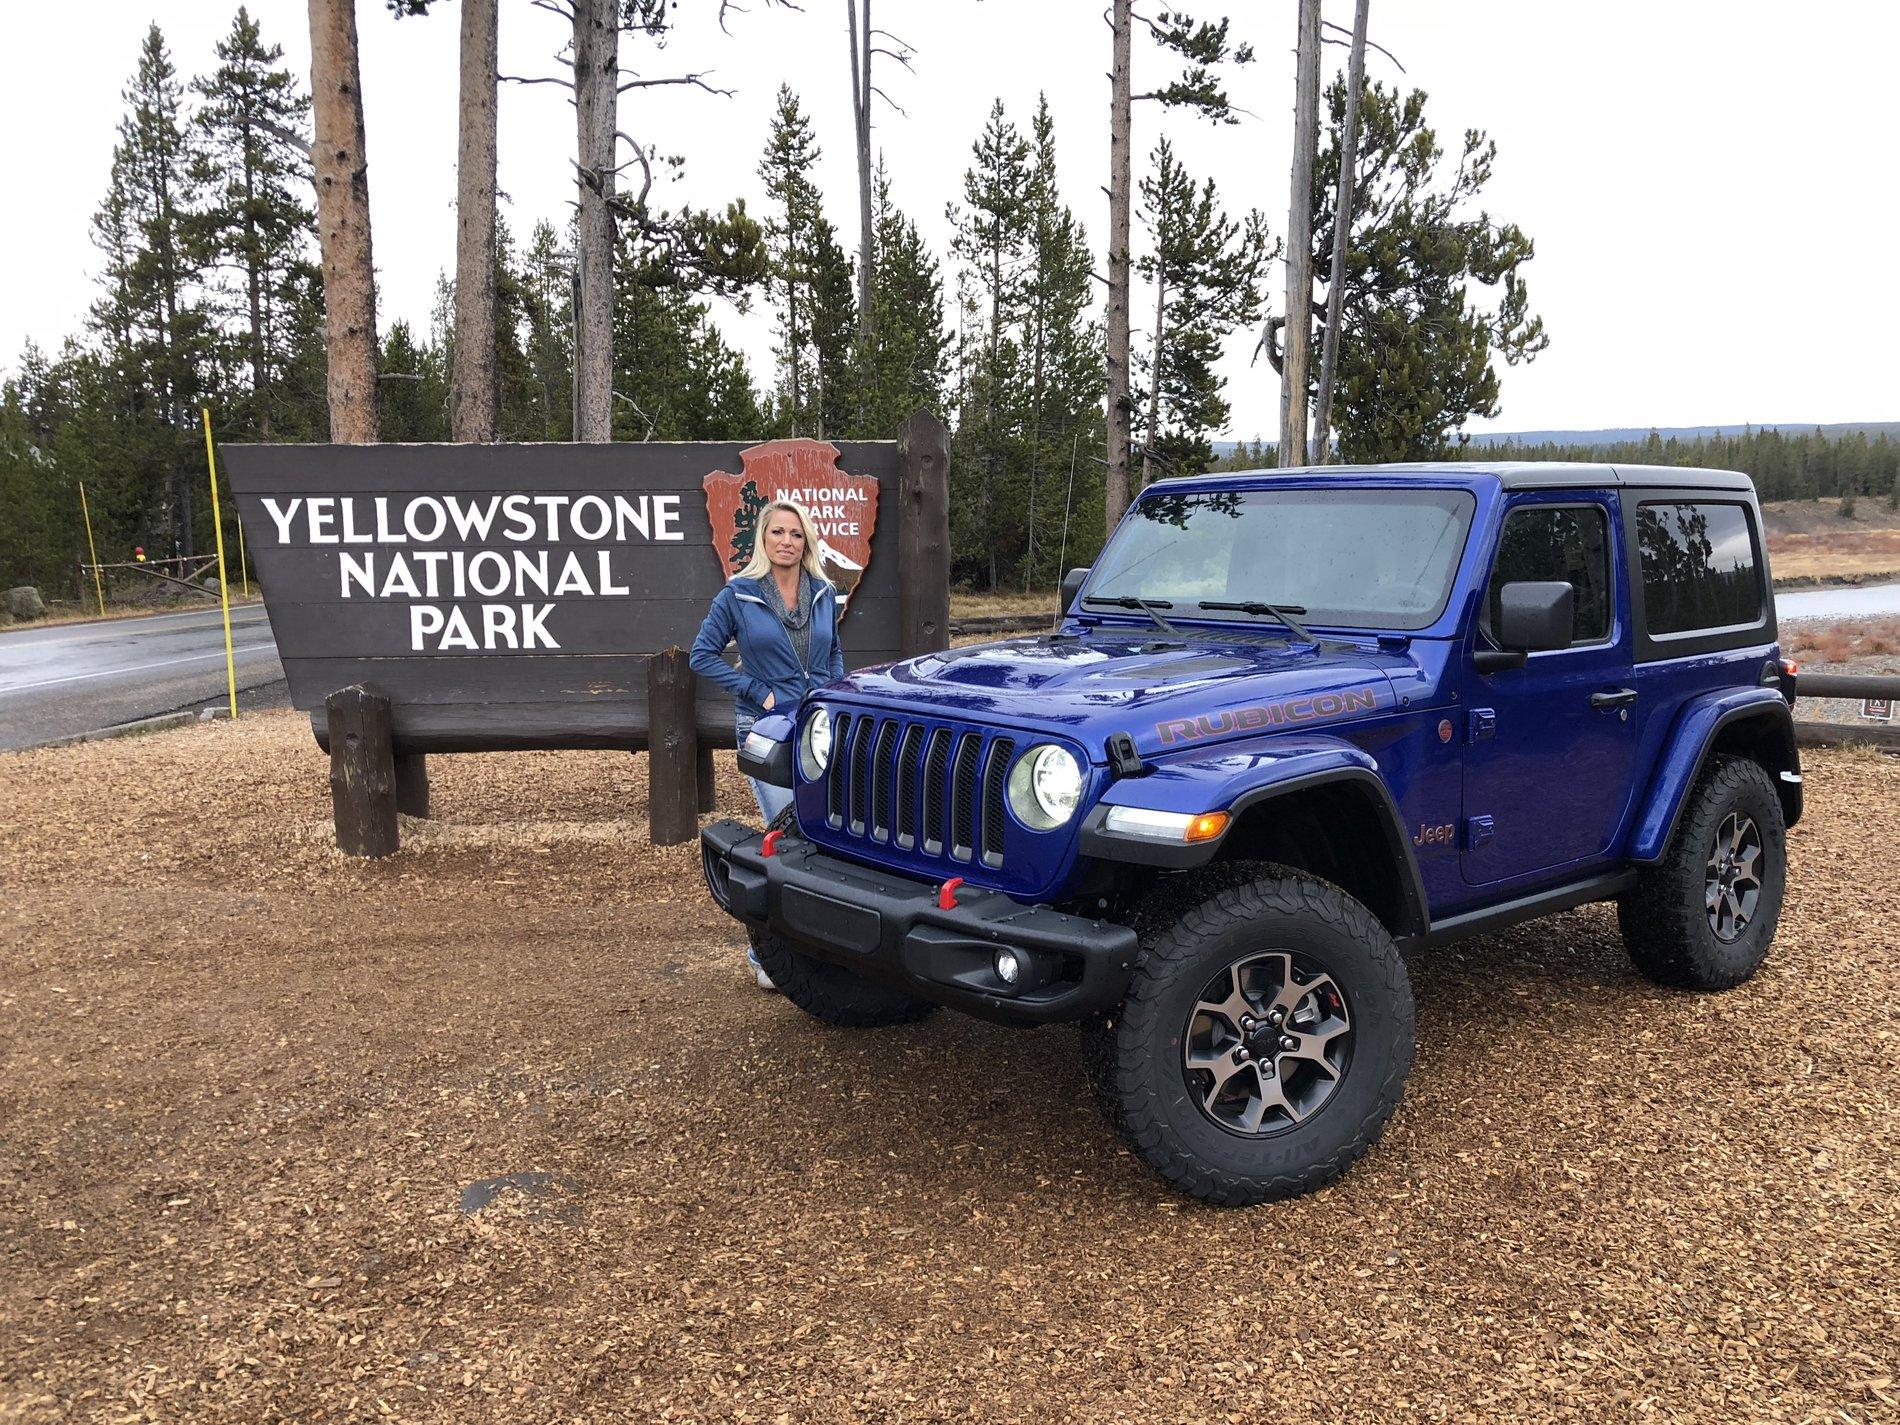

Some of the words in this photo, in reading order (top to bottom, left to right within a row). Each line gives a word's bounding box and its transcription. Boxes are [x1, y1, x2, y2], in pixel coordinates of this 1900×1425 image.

[776, 488, 868, 502] NATIONAL
[261, 495, 684, 543] YELLOWSTONE
[812, 522, 860, 536] VICE
[339, 551, 629, 597] NATIONAL
[410, 604, 561, 650] PARK
[1155, 688, 1378, 745] RUBICON
[1413, 823, 1455, 846] Jeep
